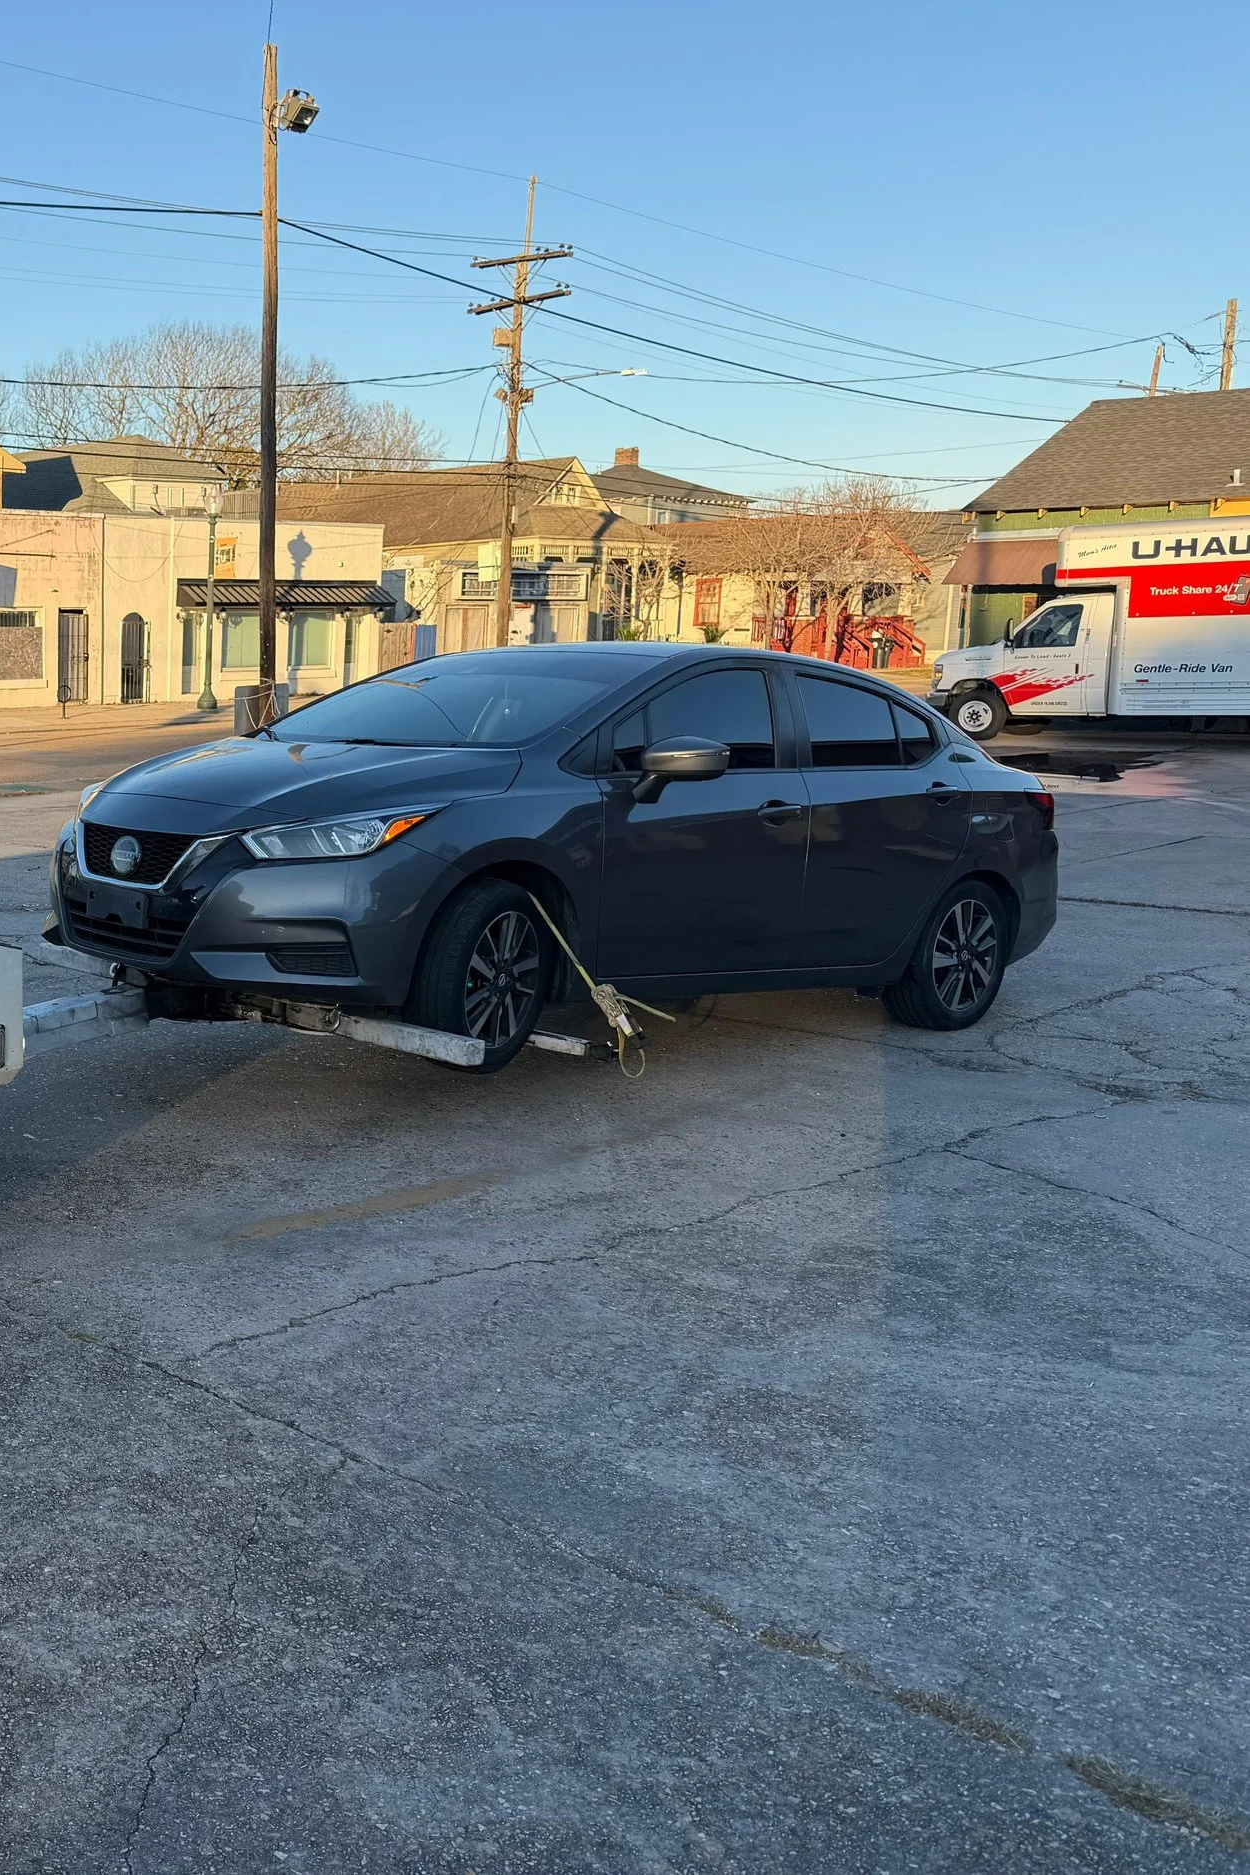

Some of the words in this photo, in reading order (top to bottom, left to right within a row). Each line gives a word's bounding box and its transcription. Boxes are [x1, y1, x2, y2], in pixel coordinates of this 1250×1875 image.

[1150, 586, 1179, 596] Truck
[1181, 585, 1213, 595] Share
[1214, 582, 1240, 595] 24/7
[1134, 663, 1207, 674] Gentle-Ride
[1211, 662, 1233, 673] Van
